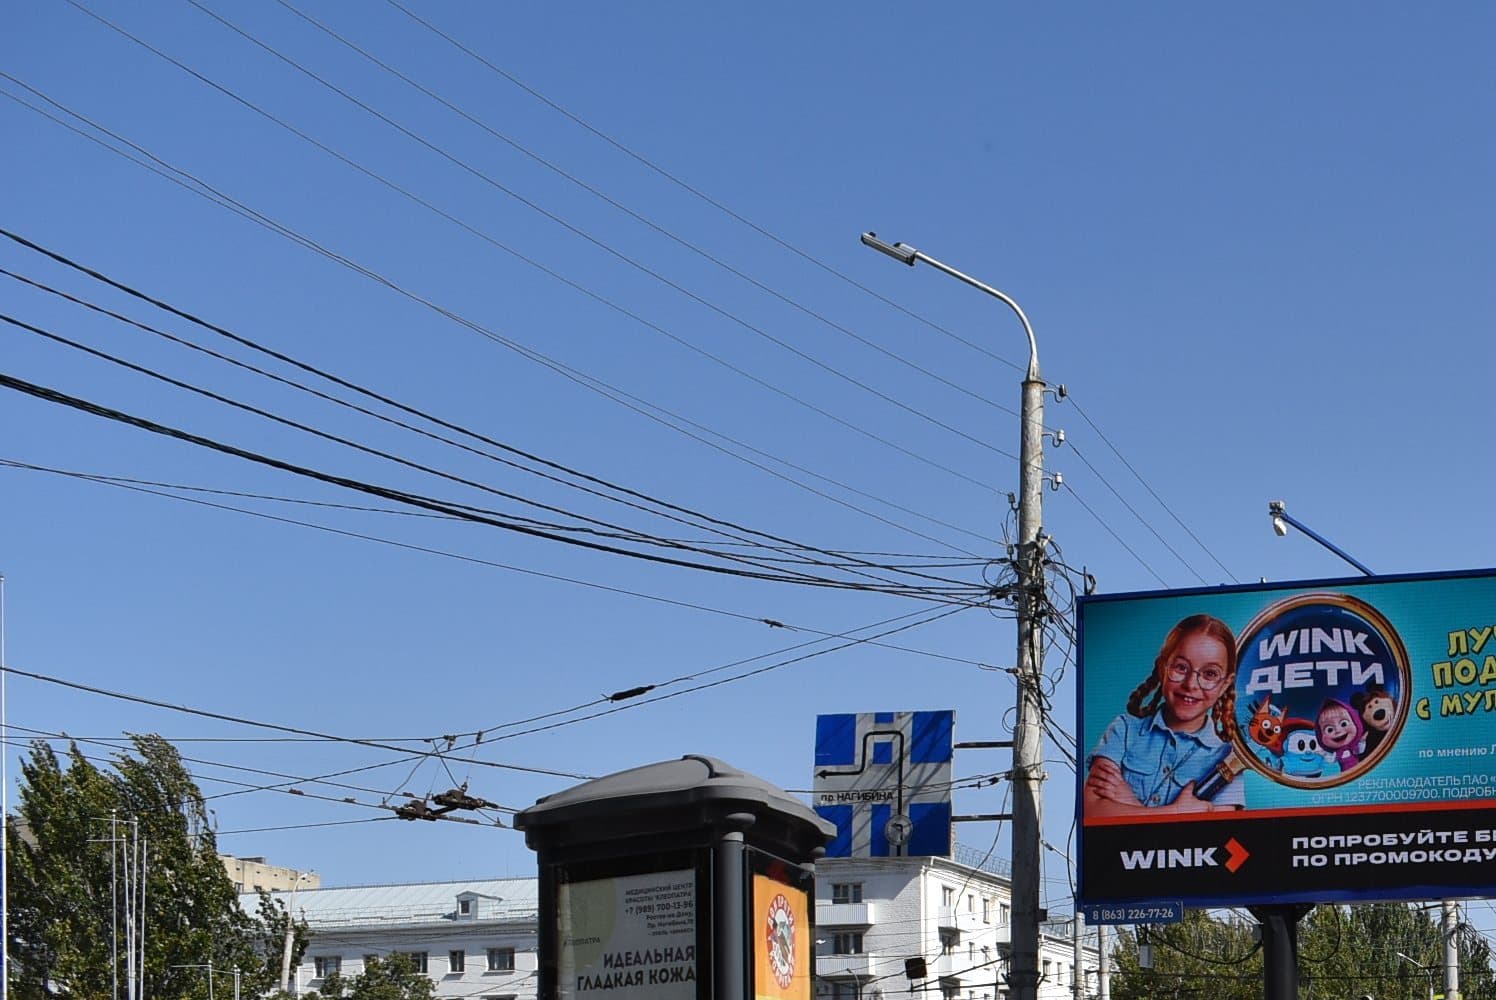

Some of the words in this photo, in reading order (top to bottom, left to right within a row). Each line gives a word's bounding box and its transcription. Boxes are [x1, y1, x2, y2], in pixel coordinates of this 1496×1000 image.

[1259, 627, 1375, 661] WINK
[1246, 660, 1384, 695] ДЕТИ
[1418, 748, 1432, 758] по
[1437, 745, 1487, 758] мнению
[1358, 774, 1462, 789] РЕКЛАМОДАТЕЛЬ
[1463, 774, 1488, 786] ПАО
[837, 791, 893, 802] НАГИБИНА
[1292, 828, 1469, 850] ПОПРОБУЙТЕ
[1120, 847, 1219, 870] WINK
[1292, 853, 1328, 868] ПО
[1092, 910, 1099, 919] 8
[1102, 908, 1125, 921] (863)
[1128, 907, 1174, 919] 226-77-26
[604, 945, 695, 969] ИДЕАЛЬНАЯ
[577, 970, 643, 991] ГЛАДКАЯ
[649, 965, 697, 985] КОЖА
